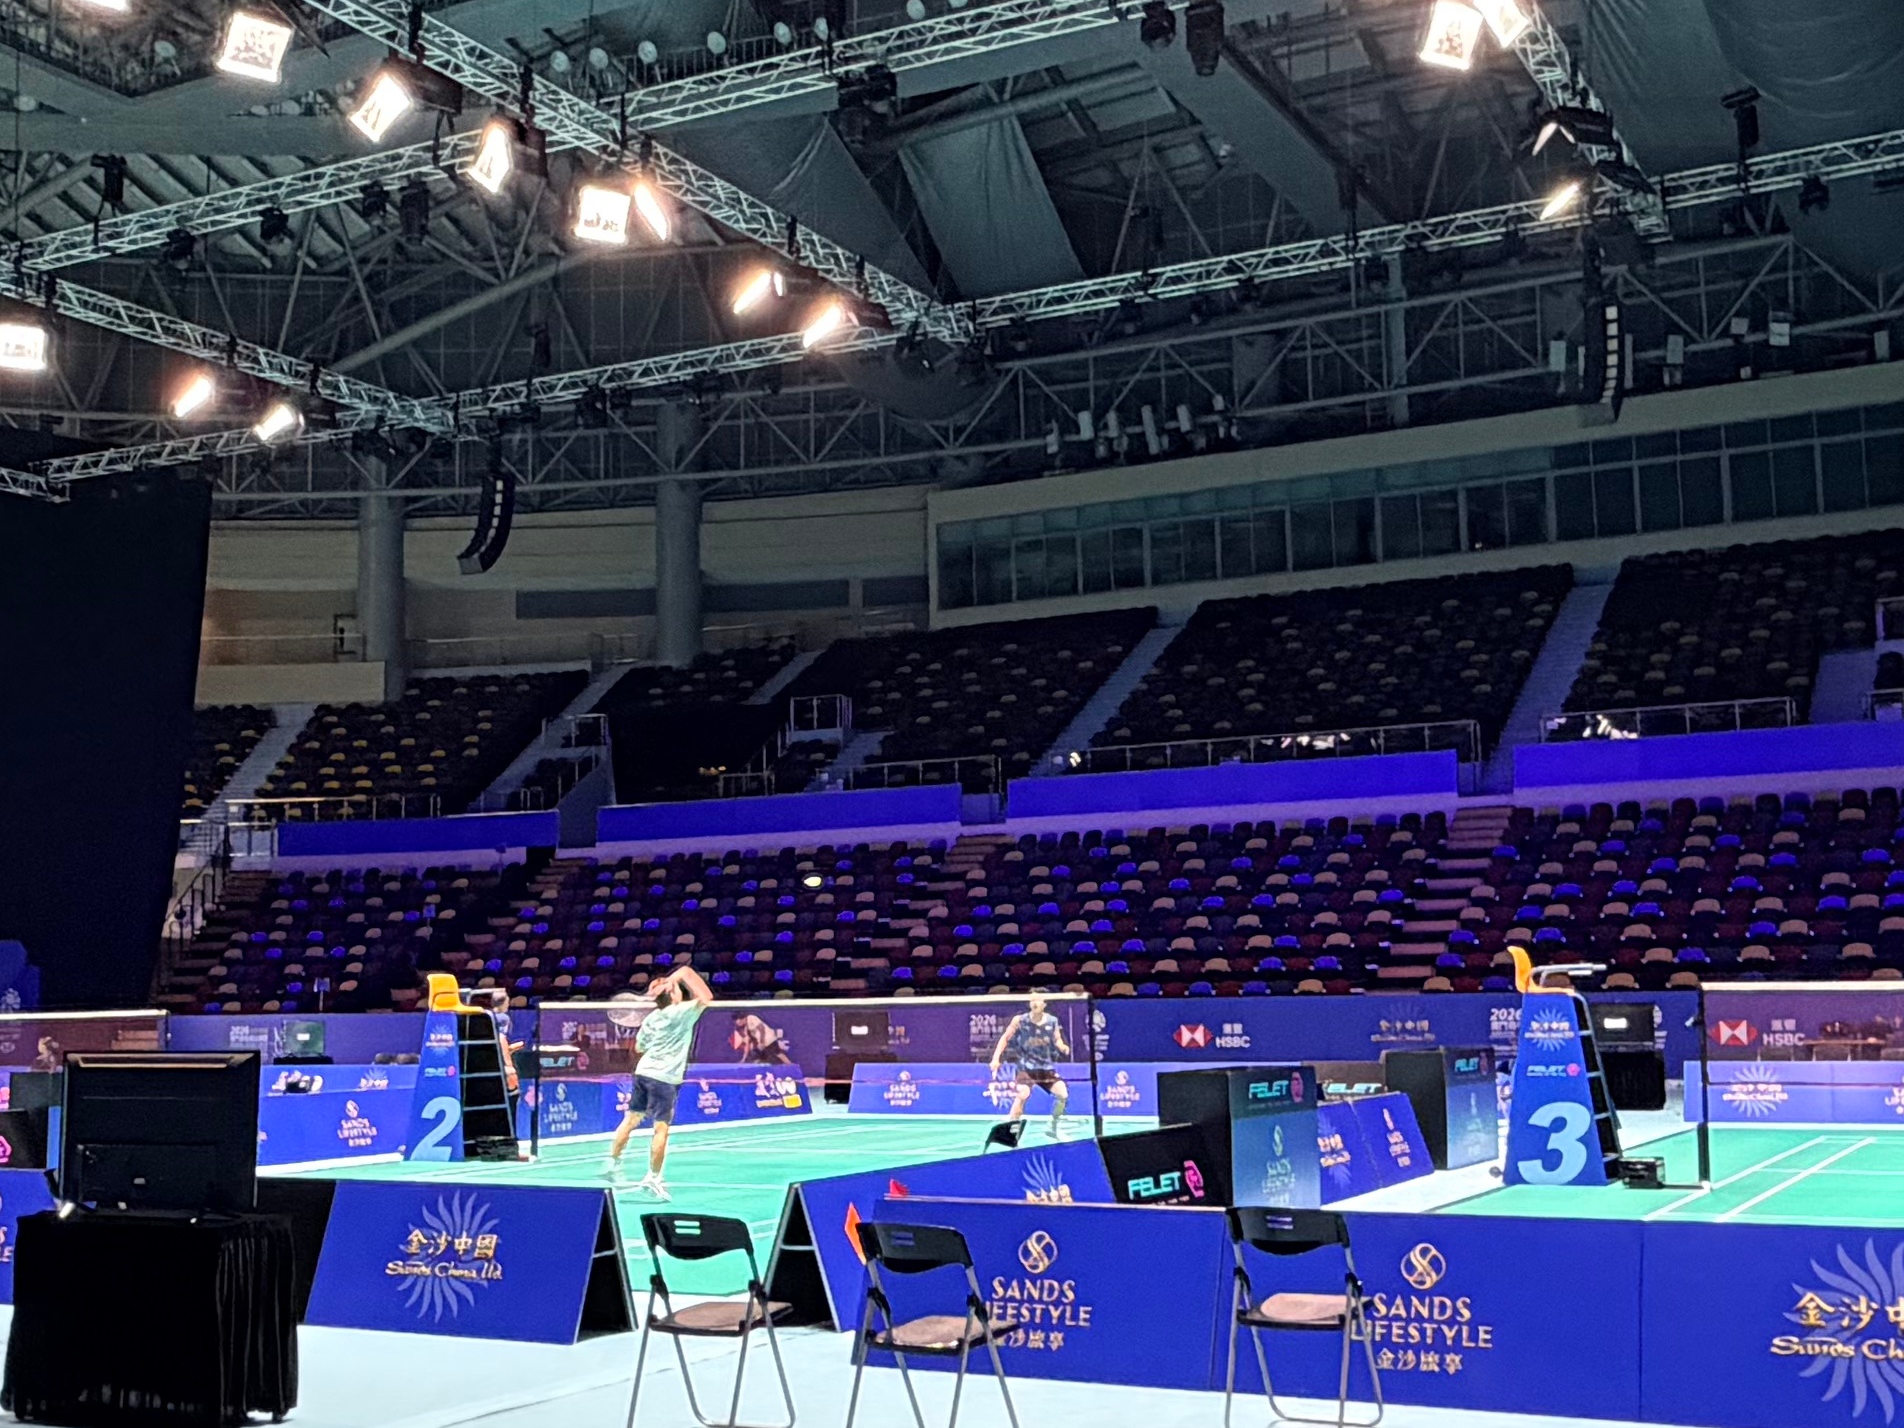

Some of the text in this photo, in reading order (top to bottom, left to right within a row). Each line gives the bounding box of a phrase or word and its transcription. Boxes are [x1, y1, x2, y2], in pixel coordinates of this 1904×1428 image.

[1215, 1035, 1251, 1049] HSBC
[1762, 1033, 1806, 1046] HSBC
[409, 1096, 462, 1162] 2
[1517, 1101, 1591, 1185] 3
[1128, 1171, 1182, 1200] FELET
[991, 1276, 1076, 1304] SANDS
[985, 1300, 1093, 1327] IFESTYLE
[1372, 1292, 1472, 1323] SANDS
[1350, 1319, 1494, 1349] LIFESTYLE
[1770, 1335, 1856, 1357] Sands
